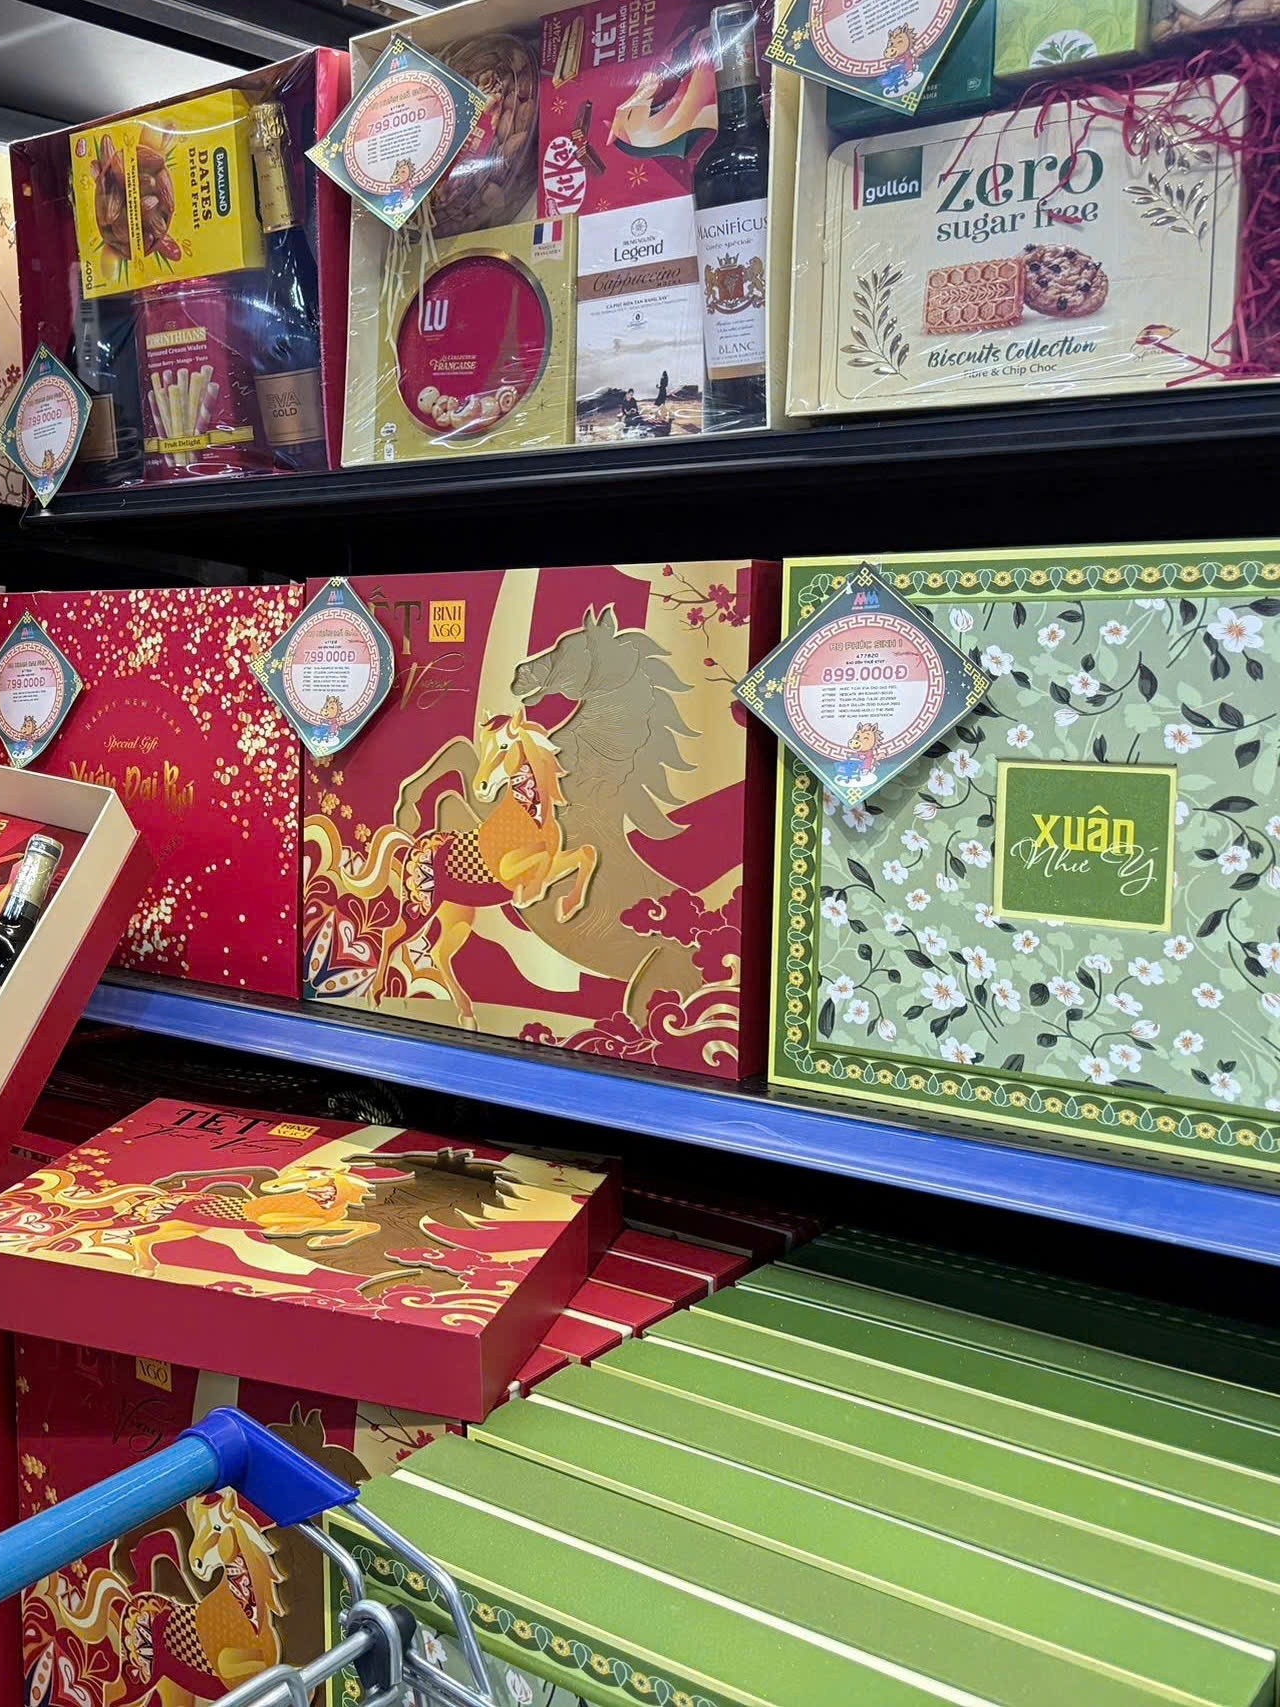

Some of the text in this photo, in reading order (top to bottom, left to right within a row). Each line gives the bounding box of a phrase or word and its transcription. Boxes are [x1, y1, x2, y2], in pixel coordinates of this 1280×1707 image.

[591, 12, 617, 68] TẾT
[198, 150, 213, 221] DATES
[214, 152, 228, 213] BAKALLAND
[544, 137, 586, 205] KitKat
[935, 148, 1105, 214] zero
[188, 147, 200, 230] Dried Fruit
[865, 178, 920, 203] gullón
[936, 201, 1099, 244] sugar free
[613, 239, 664, 262] Legend
[592, 265, 682, 296] Cappuccino
[422, 298, 449, 332] LU
[927, 336, 1098, 368] Biscuits Collection
[991, 366, 1000, 377] &
[1002, 364, 1027, 378] Chip
[1029, 362, 1058, 376] Choc
[164, 439, 201, 449] Fruit Delight
[304, 650, 357, 663] 799.000Đ
[822, 664, 909, 683] 899.000Đ
[124, 698, 149, 708] NEW
[103, 734, 160, 755] Special Gift
[171, 1107, 271, 1136] TẾT
